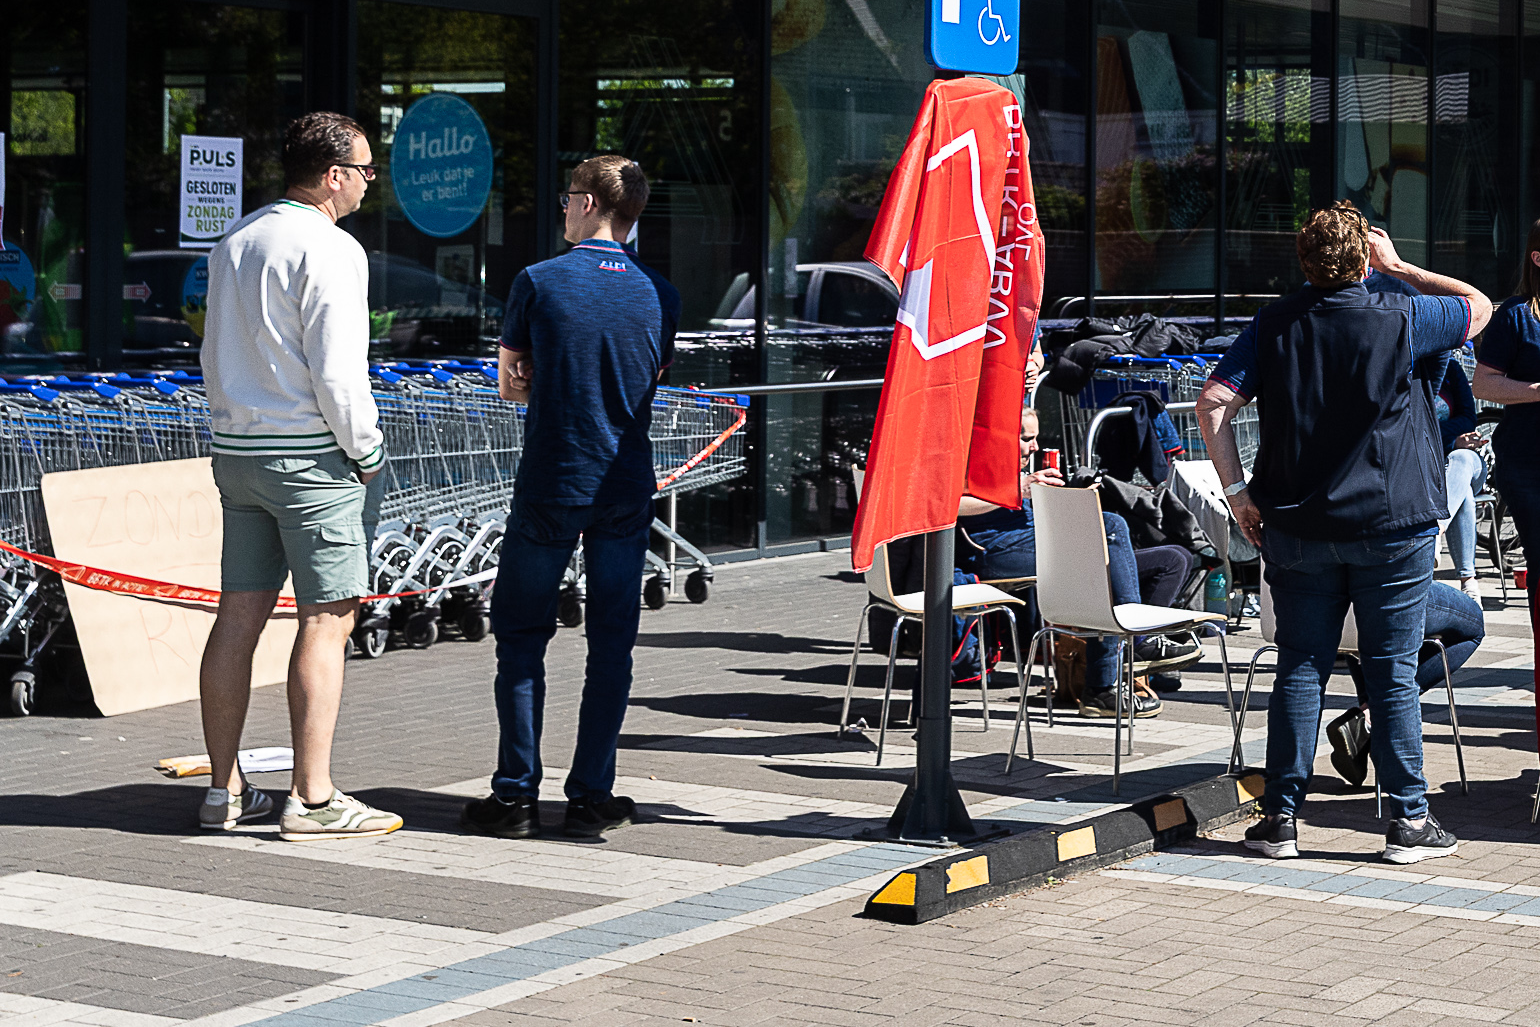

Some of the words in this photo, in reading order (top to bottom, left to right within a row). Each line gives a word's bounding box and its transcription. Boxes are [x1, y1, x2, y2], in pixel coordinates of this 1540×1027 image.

[408, 126, 478, 160] Hallo
[190, 149, 236, 167] PULS
[186, 180, 236, 195] GESLOTEN
[197, 196, 226, 204] WEGENS
[187, 205, 235, 219] ZONDAG
[196, 219, 226, 233] RUST
